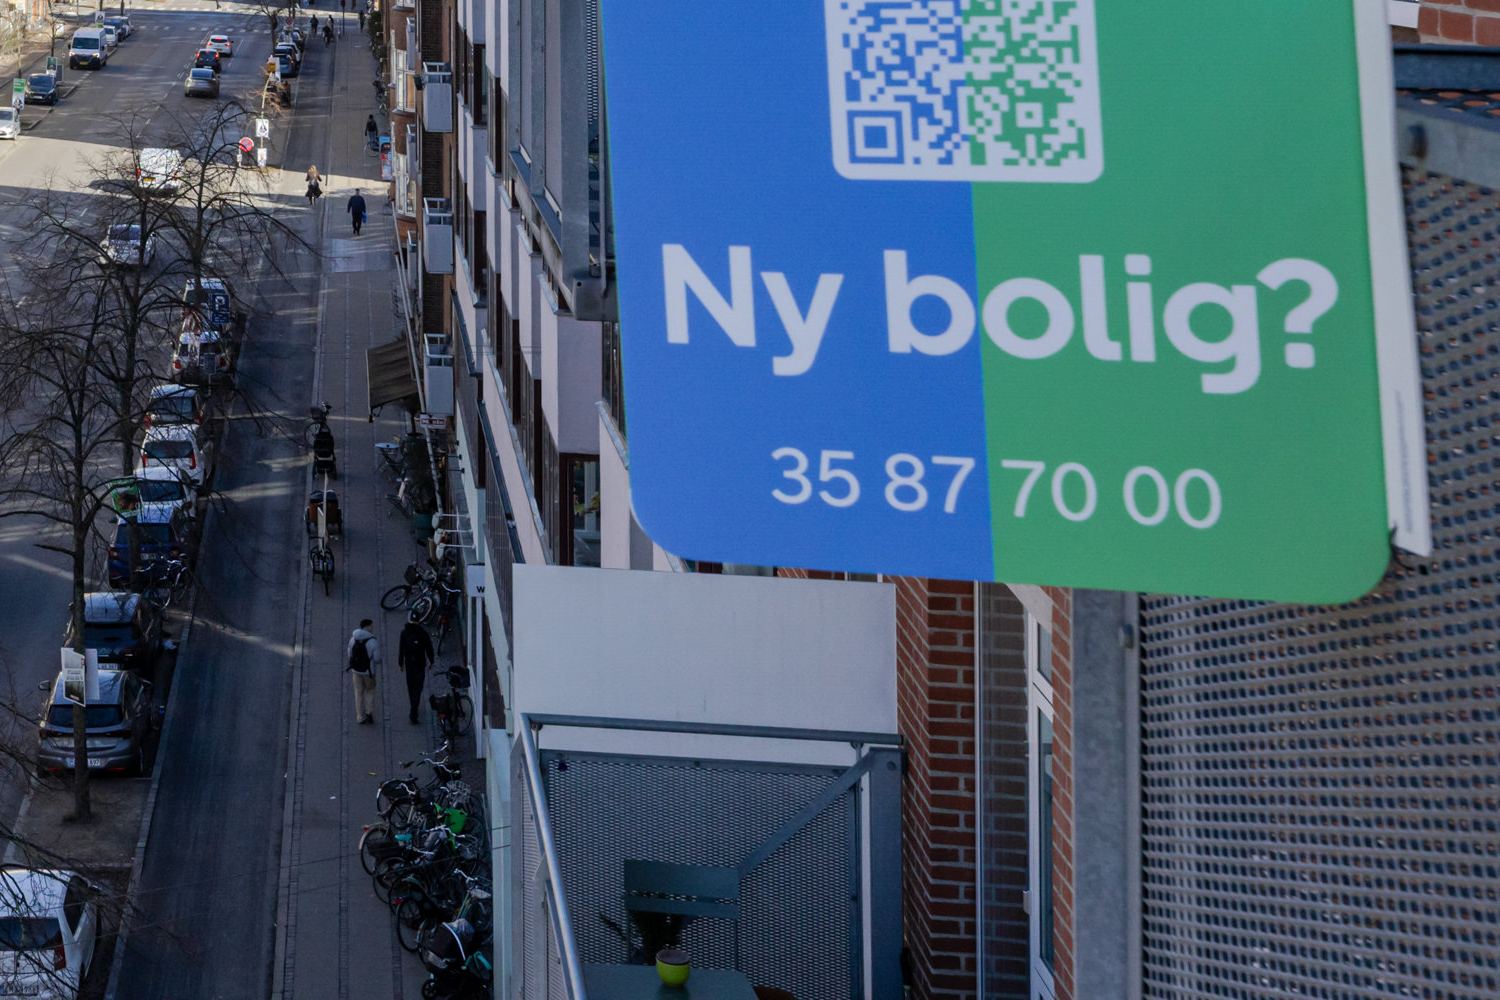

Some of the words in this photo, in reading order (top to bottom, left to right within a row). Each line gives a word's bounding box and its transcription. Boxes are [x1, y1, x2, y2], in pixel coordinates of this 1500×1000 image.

[662, 243, 844, 376] Ny
[883, 249, 1339, 396] bolig?
[770, 445, 861, 508] 35
[884, 452, 976, 514] 87
[1000, 458, 1098, 523] 70
[1121, 463, 1223, 530] 00
